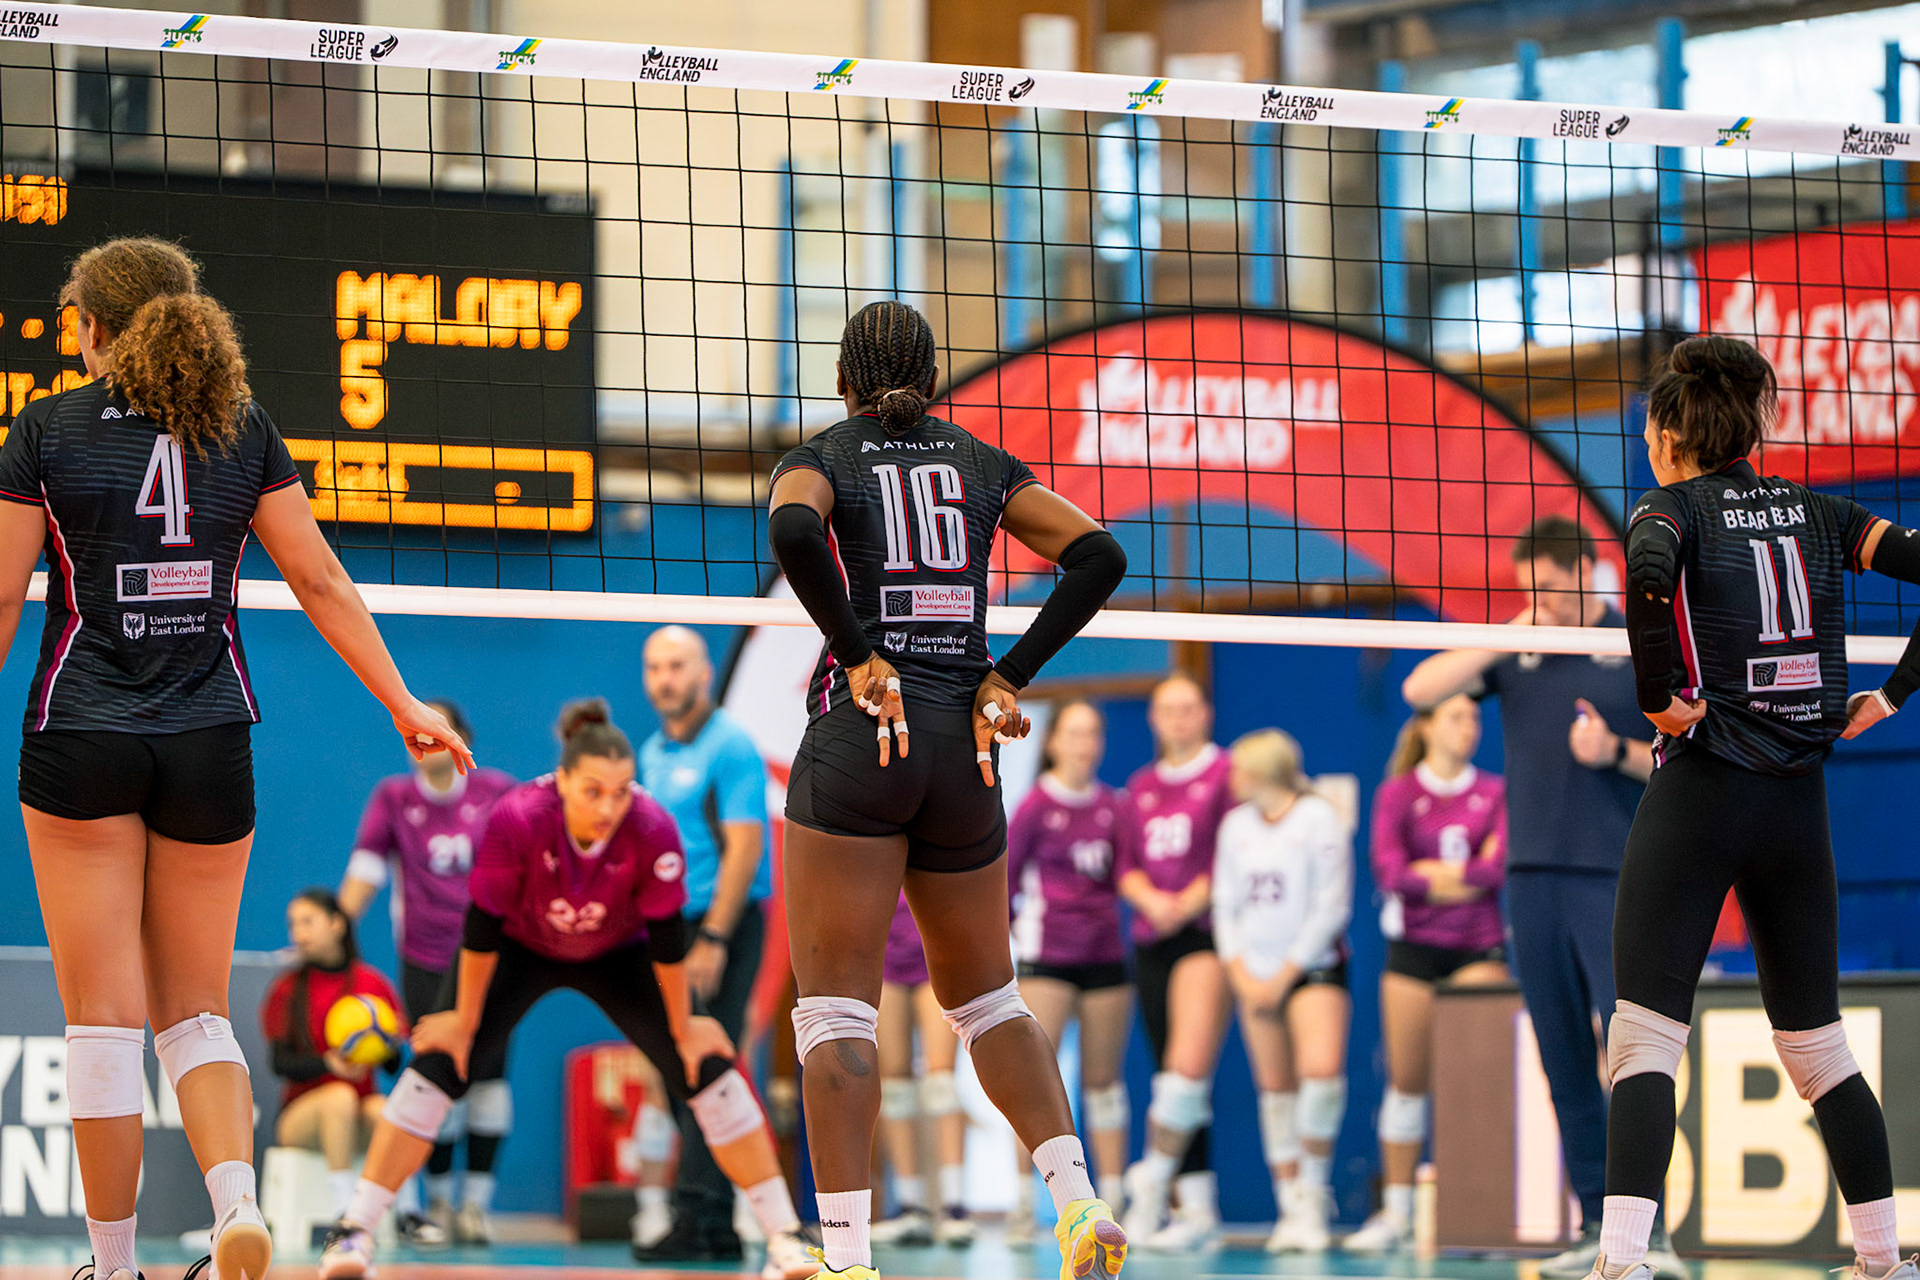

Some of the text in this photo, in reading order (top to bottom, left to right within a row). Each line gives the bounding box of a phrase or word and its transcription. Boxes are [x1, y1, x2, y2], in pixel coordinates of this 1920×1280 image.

[0, 10, 59, 27] LEYBALL
[0, 23, 40, 39] LAND
[318, 28, 365, 46] SUPER
[310, 43, 363, 61] LEAGUE
[639, 67, 700, 83] ENGLAND
[960, 71, 1004, 88] SUPER
[952, 84, 1002, 101] LEAGUE
[1260, 106, 1317, 121] ENGLAND
[1559, 109, 1601, 125] SUPER
[1552, 122, 1599, 139] LEAGUE
[1841, 141, 1895, 155] ENGLAND
[340, 339, 388, 430] 5
[882, 440, 956, 450] ATHLIFY
[134, 433, 195, 547] 4
[871, 463, 970, 573] 16
[1722, 508, 1770, 531] BEAR
[150, 565, 209, 581] Volleyball
[915, 589, 971, 604] Volleyball
[1748, 535, 1815, 645] 11
[149, 612, 207, 626] University of
[150, 623, 205, 636] East London
[911, 634, 968, 647] University of
[910, 644, 966, 655] East London
[1773, 700, 1821, 714] University of
[1790, 710, 1823, 722] London
